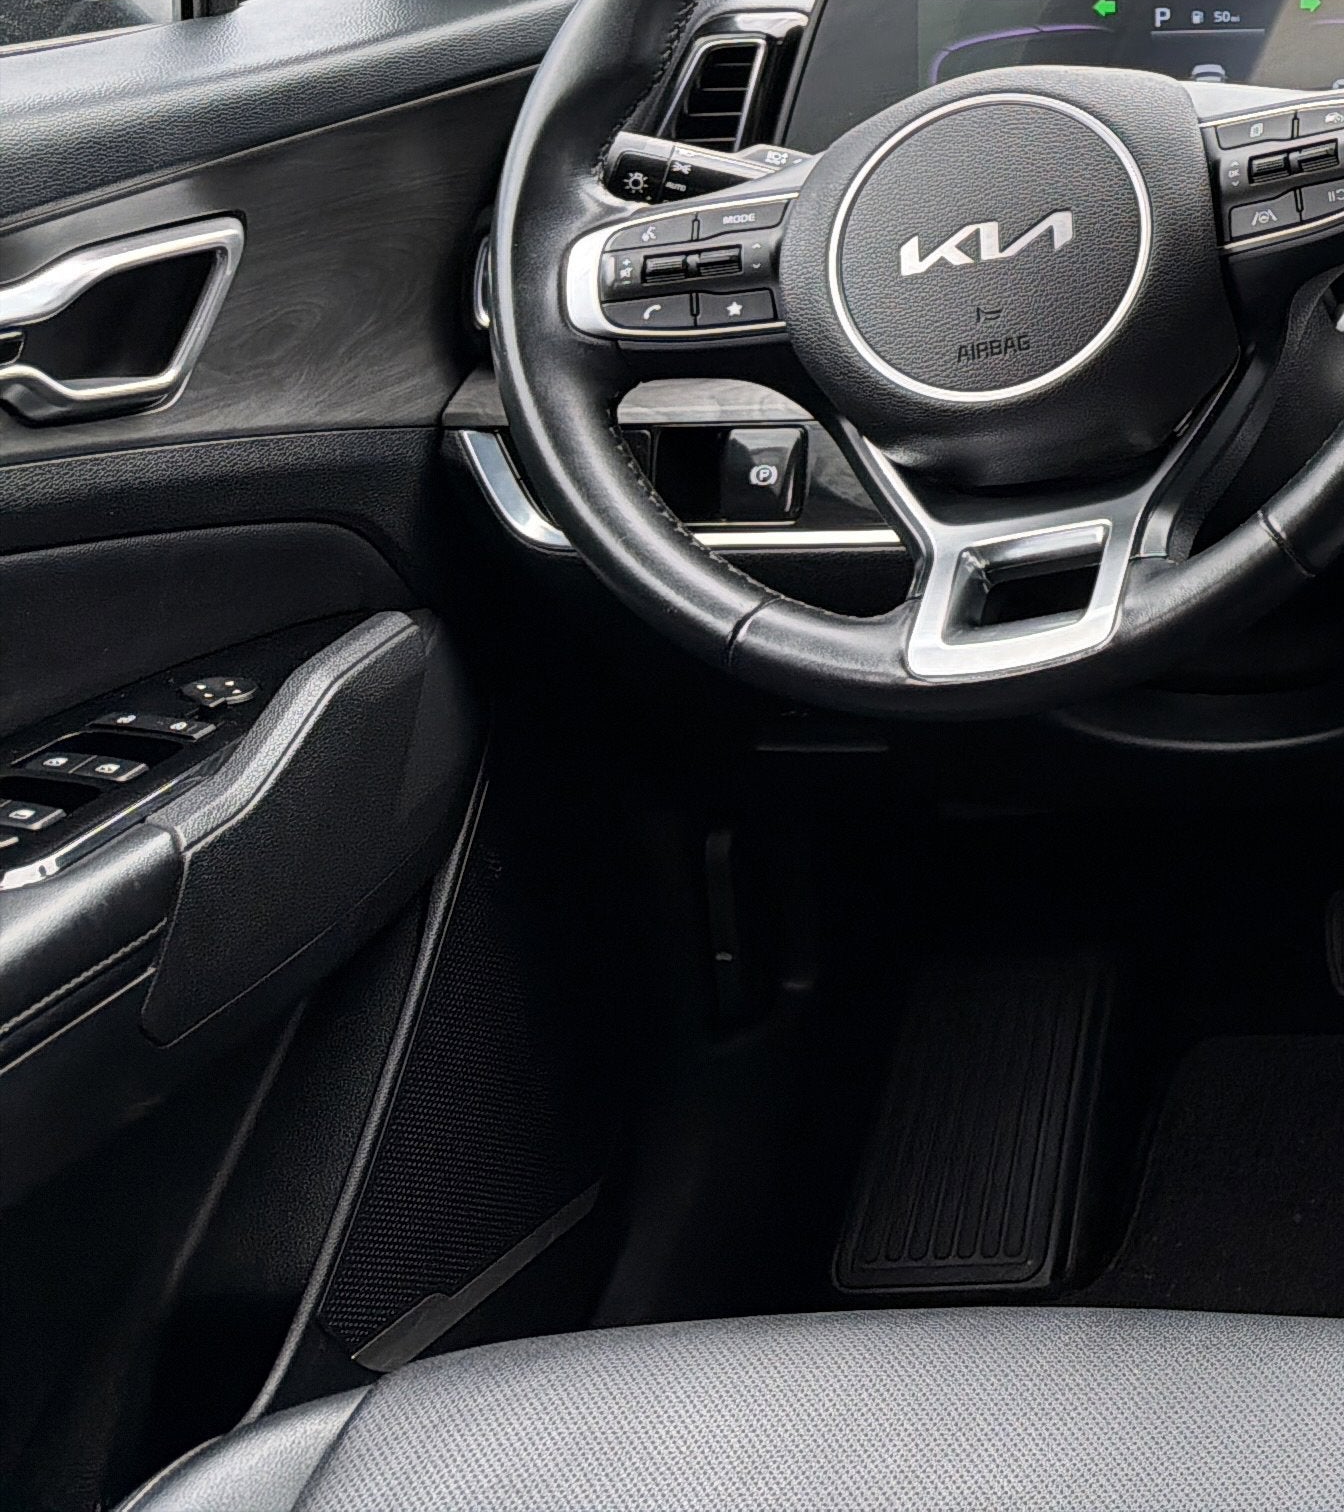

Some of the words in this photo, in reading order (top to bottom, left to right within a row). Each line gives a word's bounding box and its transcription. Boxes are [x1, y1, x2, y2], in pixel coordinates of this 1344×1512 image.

[1154, 7, 1171, 27] P
[1227, 168, 1241, 178] OK
[722, 213, 756, 225] MODE
[900, 209, 1073, 277] KIA
[956, 334, 1031, 364] AIRBAG
